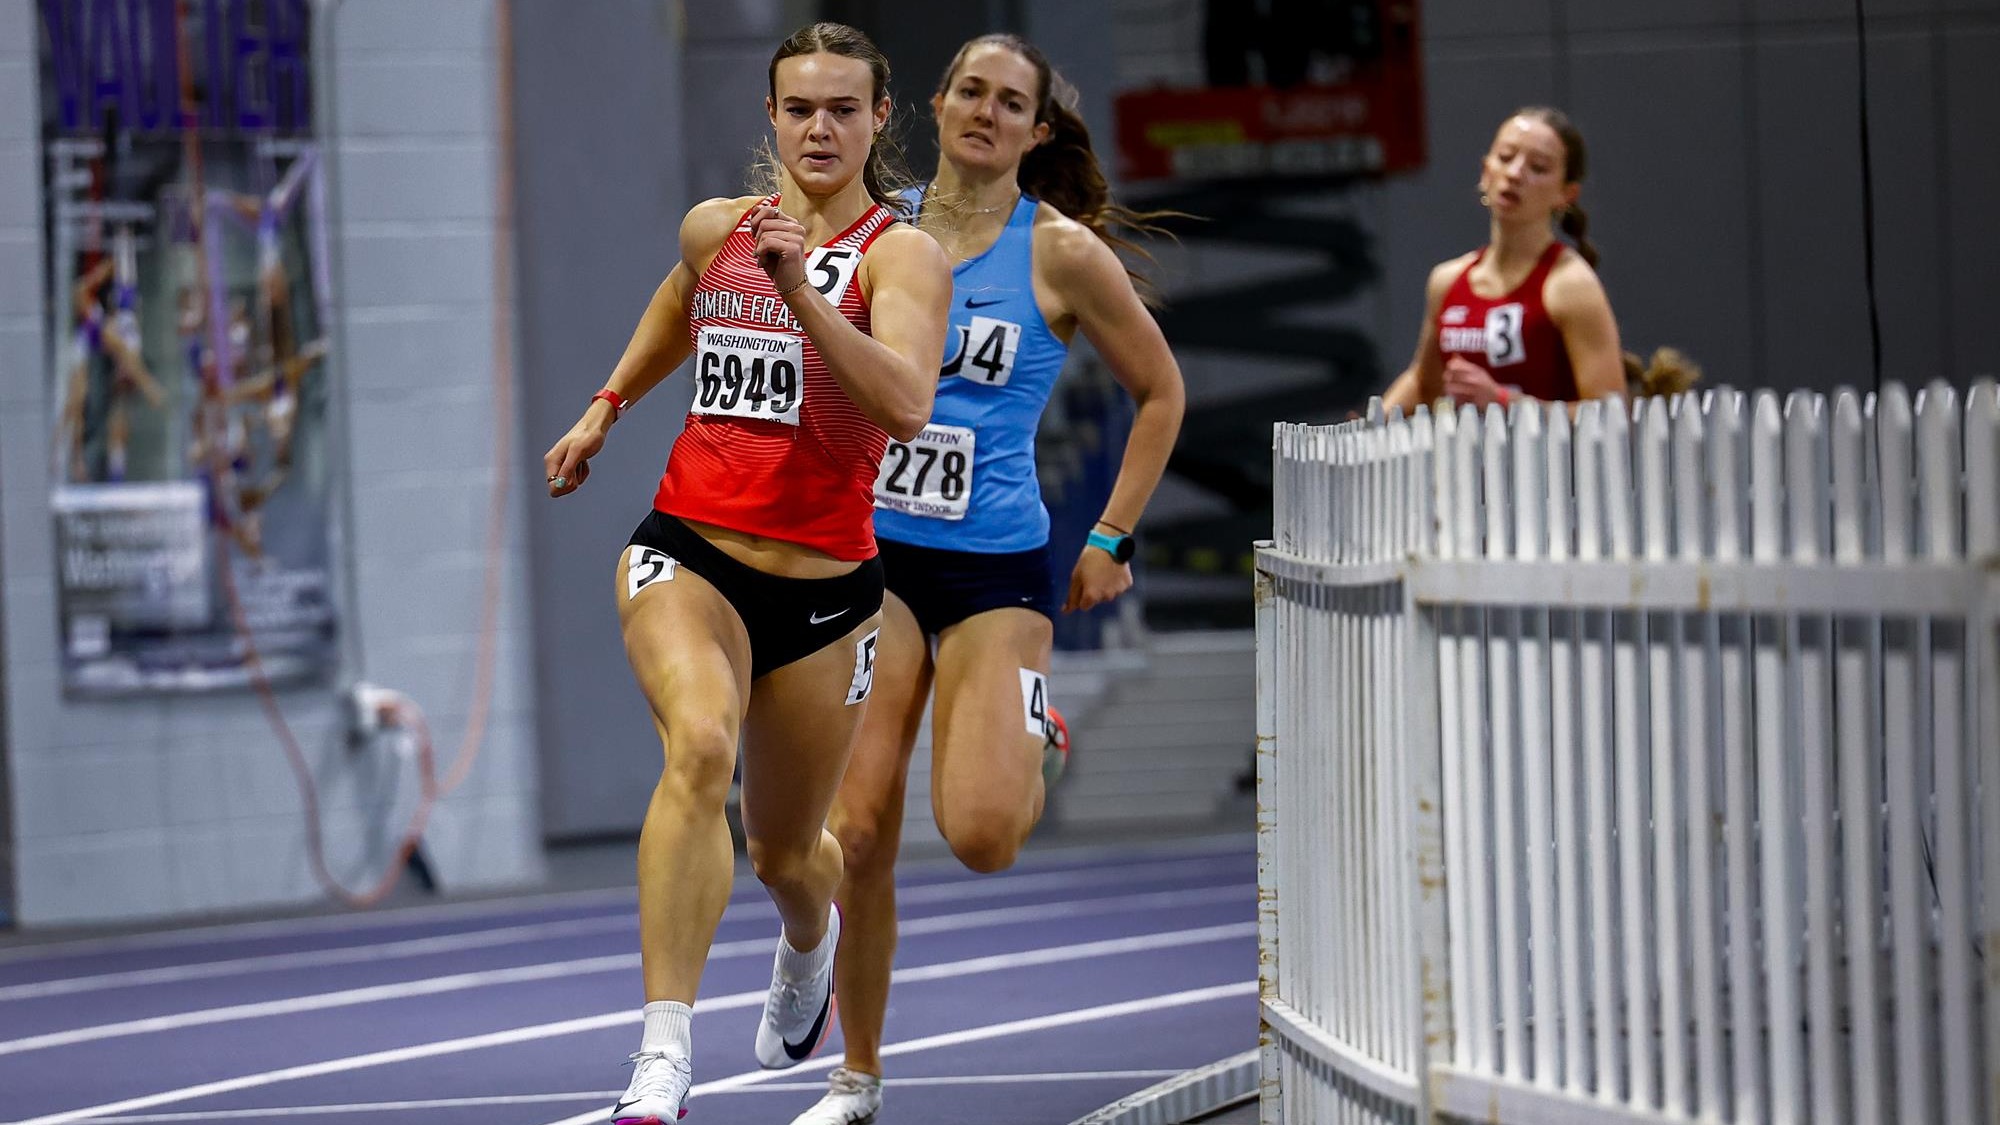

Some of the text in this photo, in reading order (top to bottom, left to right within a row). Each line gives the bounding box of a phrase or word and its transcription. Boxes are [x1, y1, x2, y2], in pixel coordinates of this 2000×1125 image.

[813, 251, 853, 296] 5
[692, 288, 744, 320] SIMON
[707, 333, 788, 354] WASHINGTON
[971, 325, 1007, 382] 4
[1495, 313, 1512, 360] 3
[700, 352, 797, 414] 6949
[884, 443, 967, 501] 278
[636, 549, 671, 589] 5
[855, 635, 877, 700] 5
[1029, 676, 1046, 734] 4
